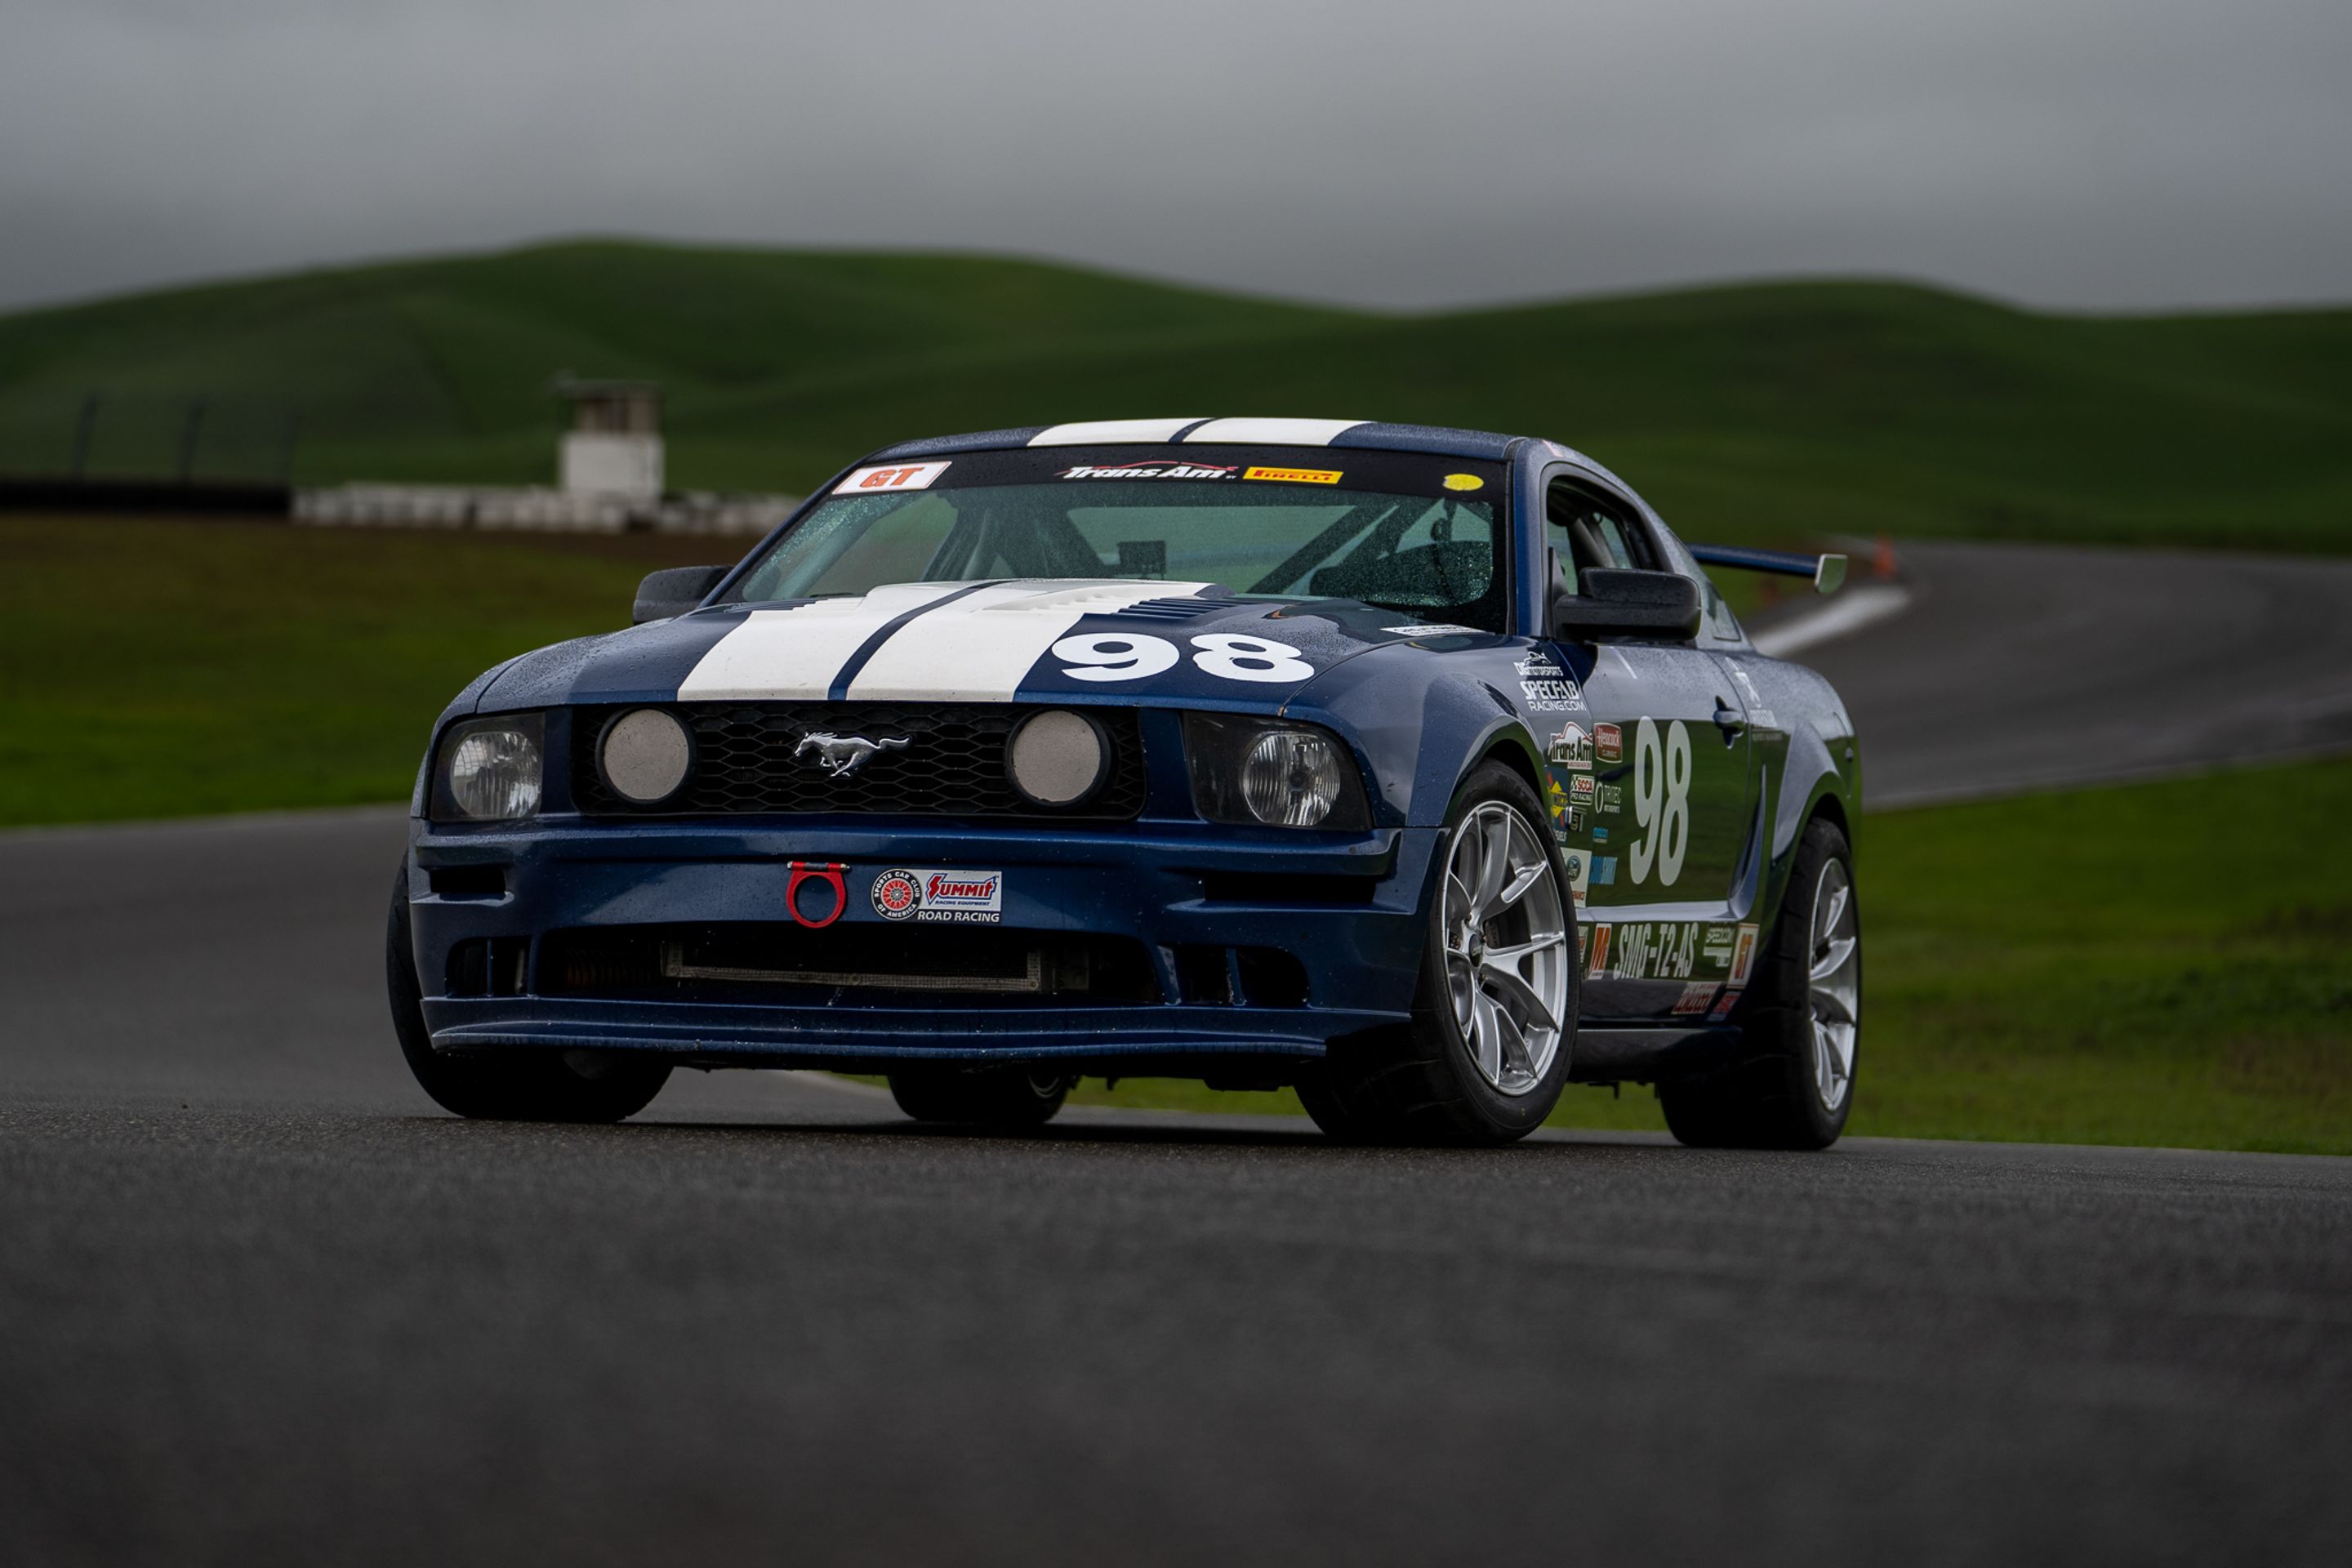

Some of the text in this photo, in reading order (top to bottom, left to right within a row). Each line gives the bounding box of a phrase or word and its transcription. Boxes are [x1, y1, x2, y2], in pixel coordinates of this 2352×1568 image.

[860, 467, 924, 488] GT
[1063, 466, 1162, 479] Trans
[1157, 466, 1226, 479] Am
[1254, 470, 1333, 481] PIRELLI
[1051, 632, 1315, 683] 98
[1520, 679, 1580, 700] SPECFAB
[1527, 700, 1587, 711] RACING.COM
[1577, 778, 1592, 791] SCCA
[1630, 715, 1692, 887] 98
[874, 871, 920, 898] SPORTS CAR CLUB
[887, 903, 917, 917] AMERICA
[917, 911, 1000, 922] ROAD RACING
